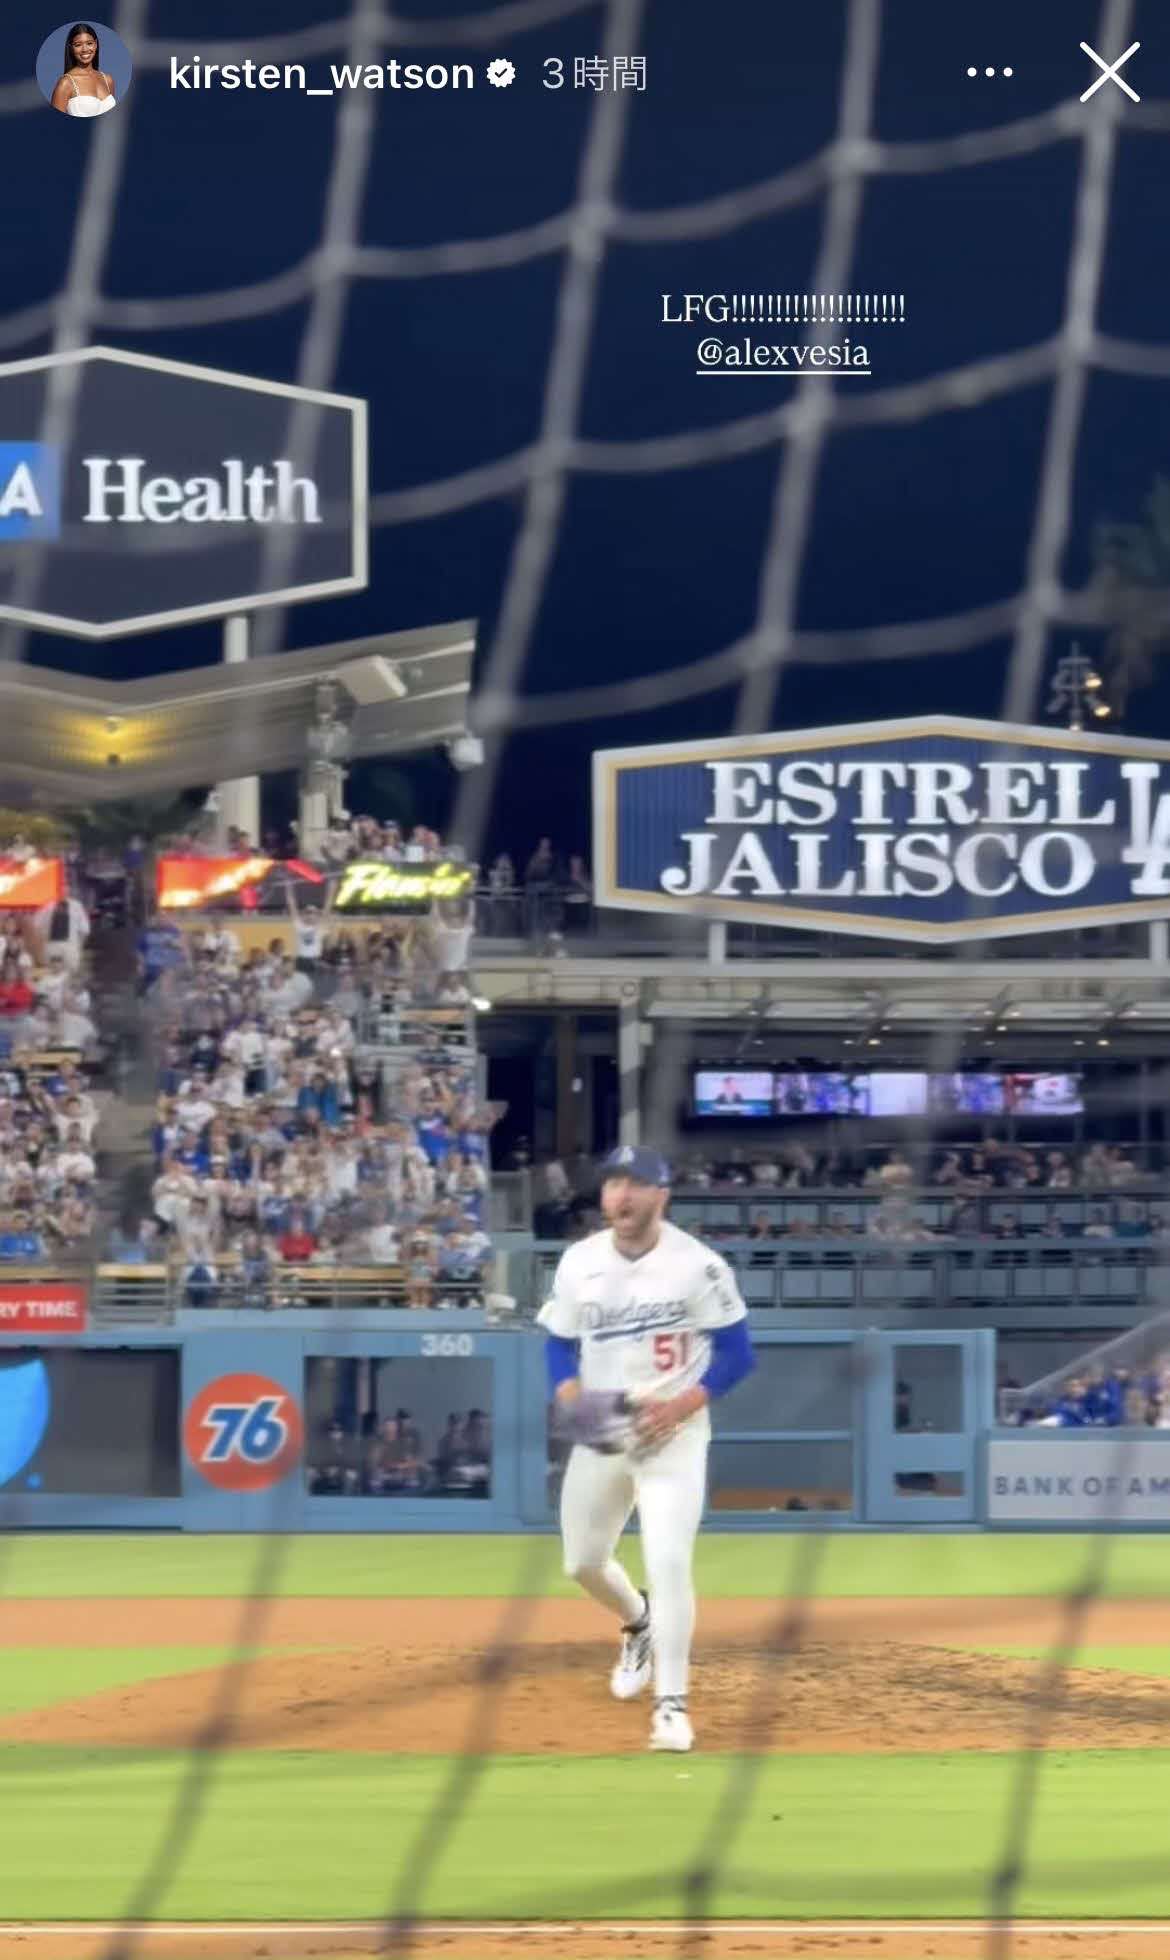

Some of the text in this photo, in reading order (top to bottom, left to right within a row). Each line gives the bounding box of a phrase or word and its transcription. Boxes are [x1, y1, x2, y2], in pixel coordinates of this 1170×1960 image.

[82, 457, 322, 524] Health
[704, 760, 1116, 826] ESTREL
[659, 830, 1096, 897] JALISCO
[26, 1300, 78, 1319] TIME
[580, 1297, 690, 1338] Dodgers
[420, 1333, 476, 1357] 360
[653, 1332, 691, 1372] 51
[202, 1397, 288, 1463] 76
[994, 1475, 1073, 1496] BANK
[1082, 1475, 1118, 1496] OF
